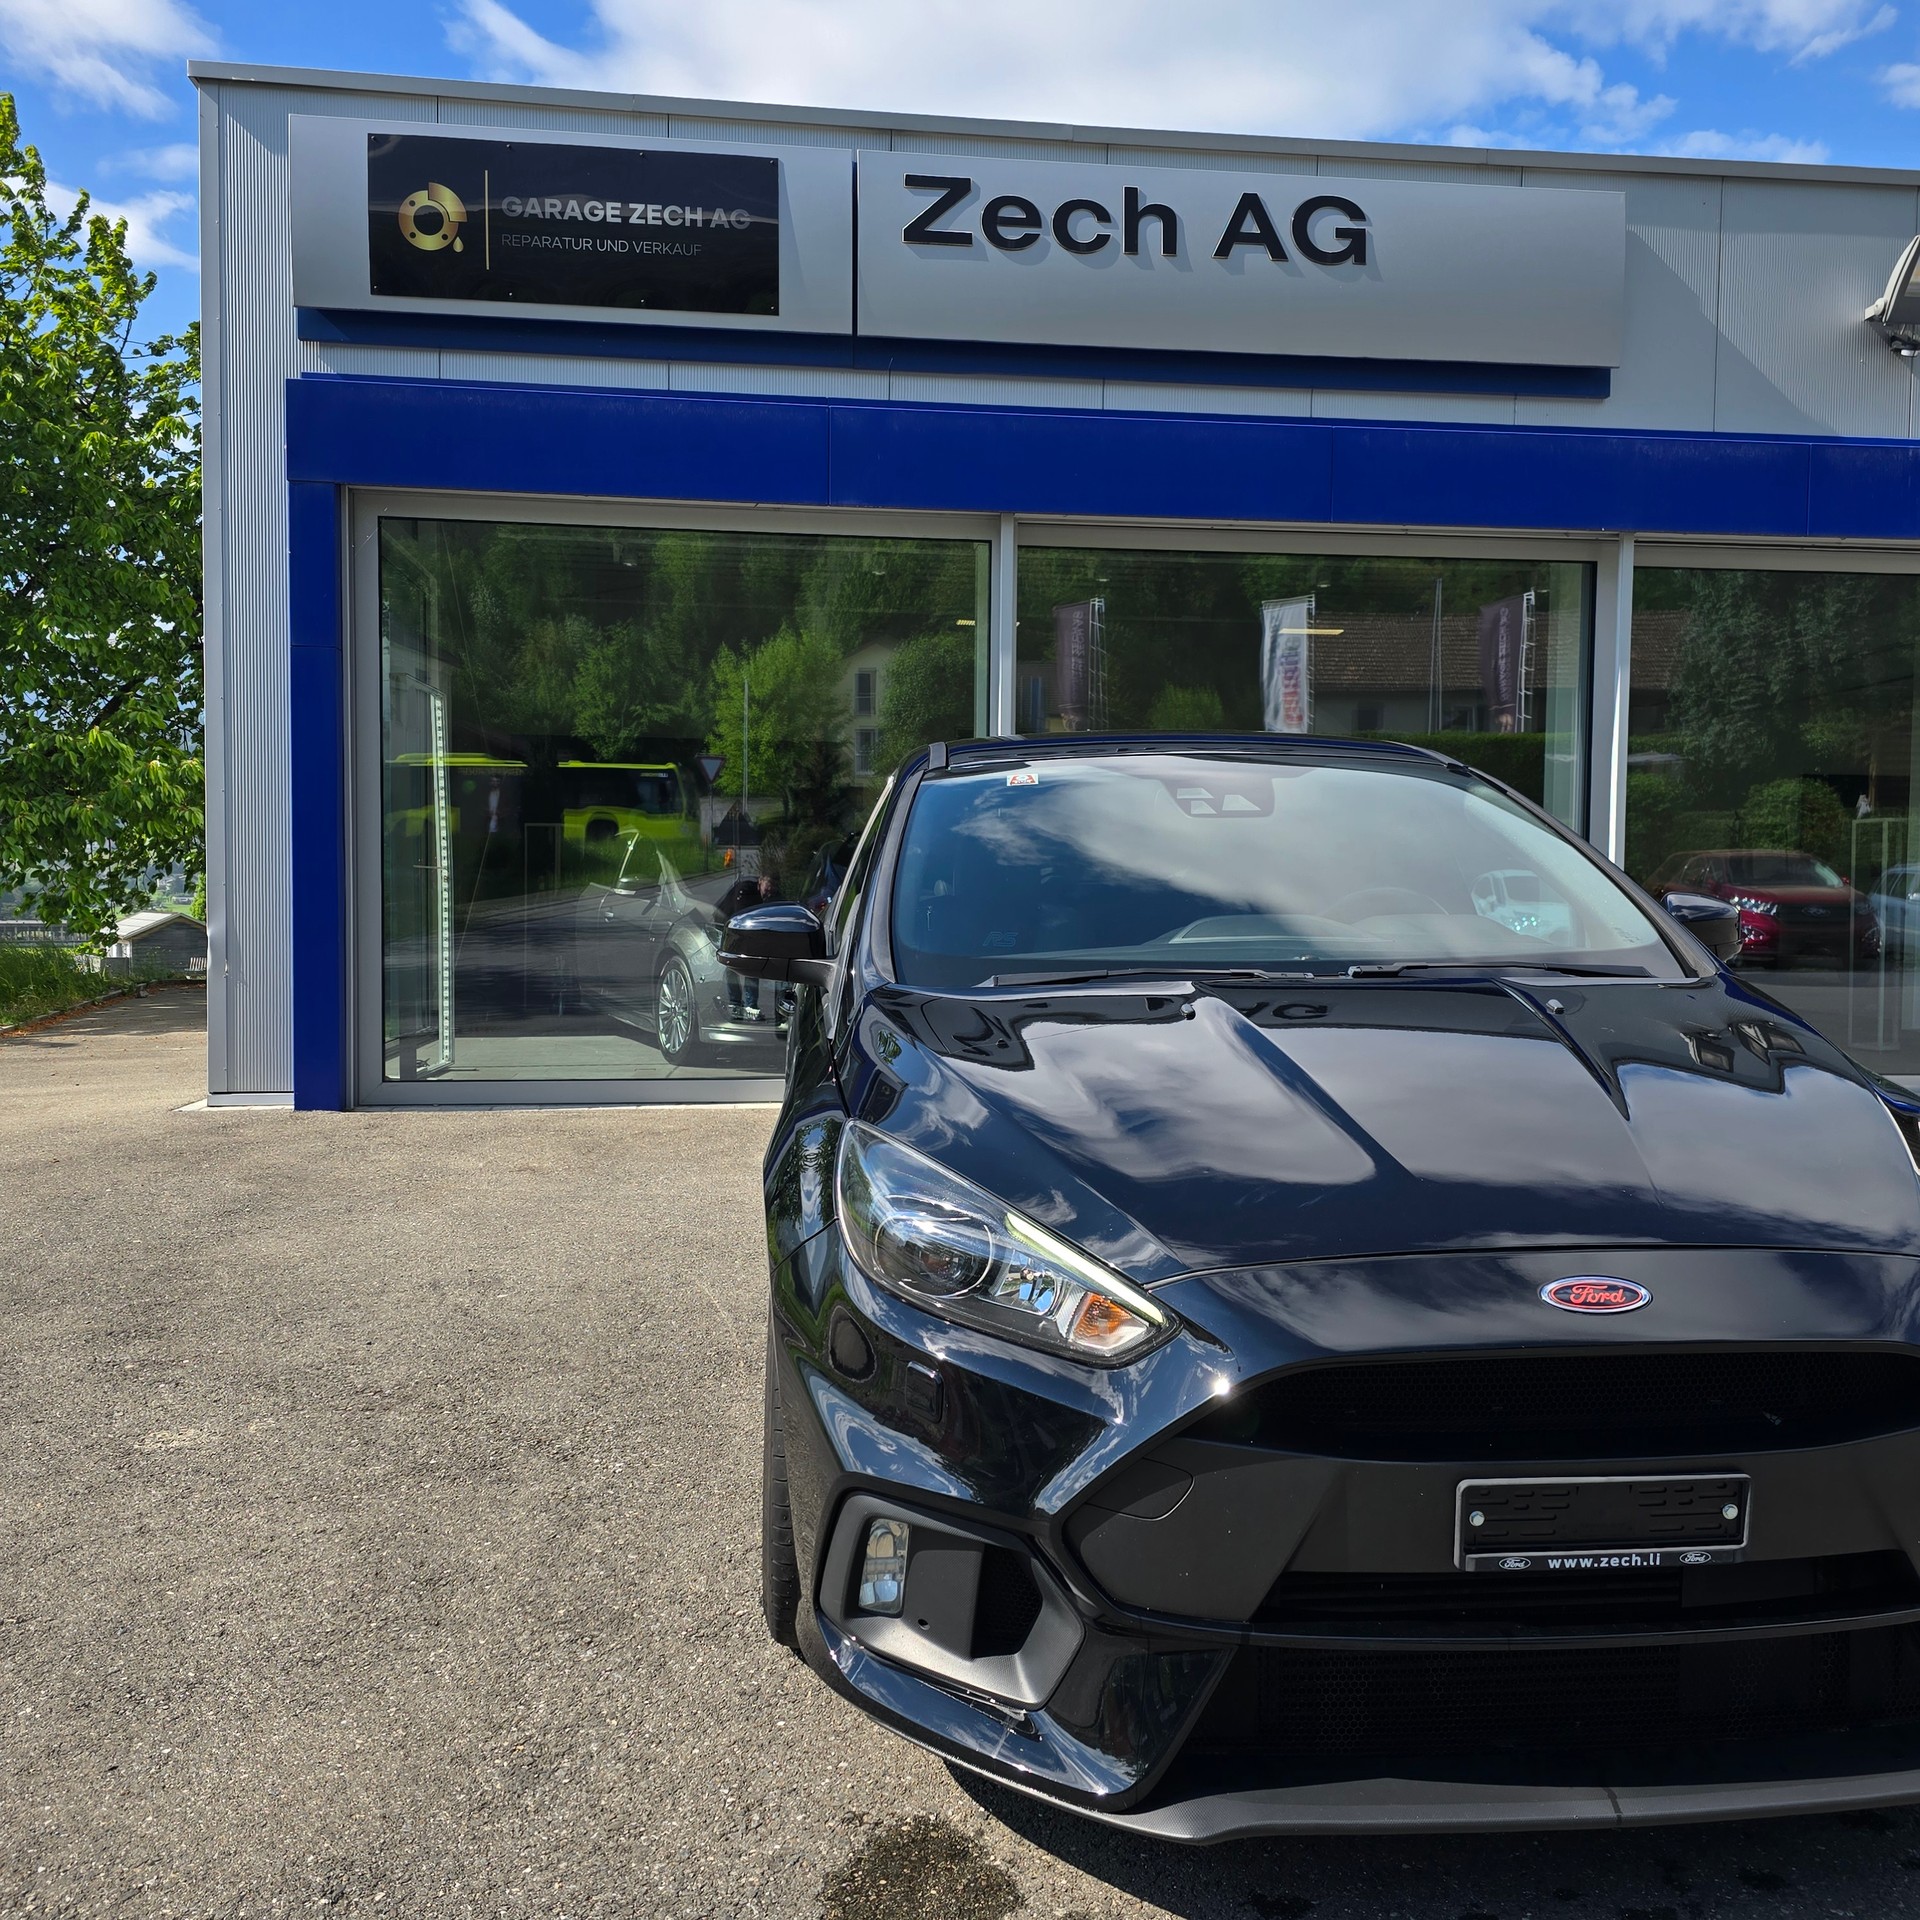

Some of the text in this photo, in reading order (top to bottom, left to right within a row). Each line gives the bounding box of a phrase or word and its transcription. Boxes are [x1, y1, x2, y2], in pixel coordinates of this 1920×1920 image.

[501, 196, 751, 230] GARAGE ZECH AG
[901, 173, 1367, 266] Zech AG
[501, 233, 702, 256] REPARATUR UND VERKAUF
[1570, 1284, 1626, 1304] Ford
[1504, 1552, 1706, 1569] Ford www.zech.li Ford
